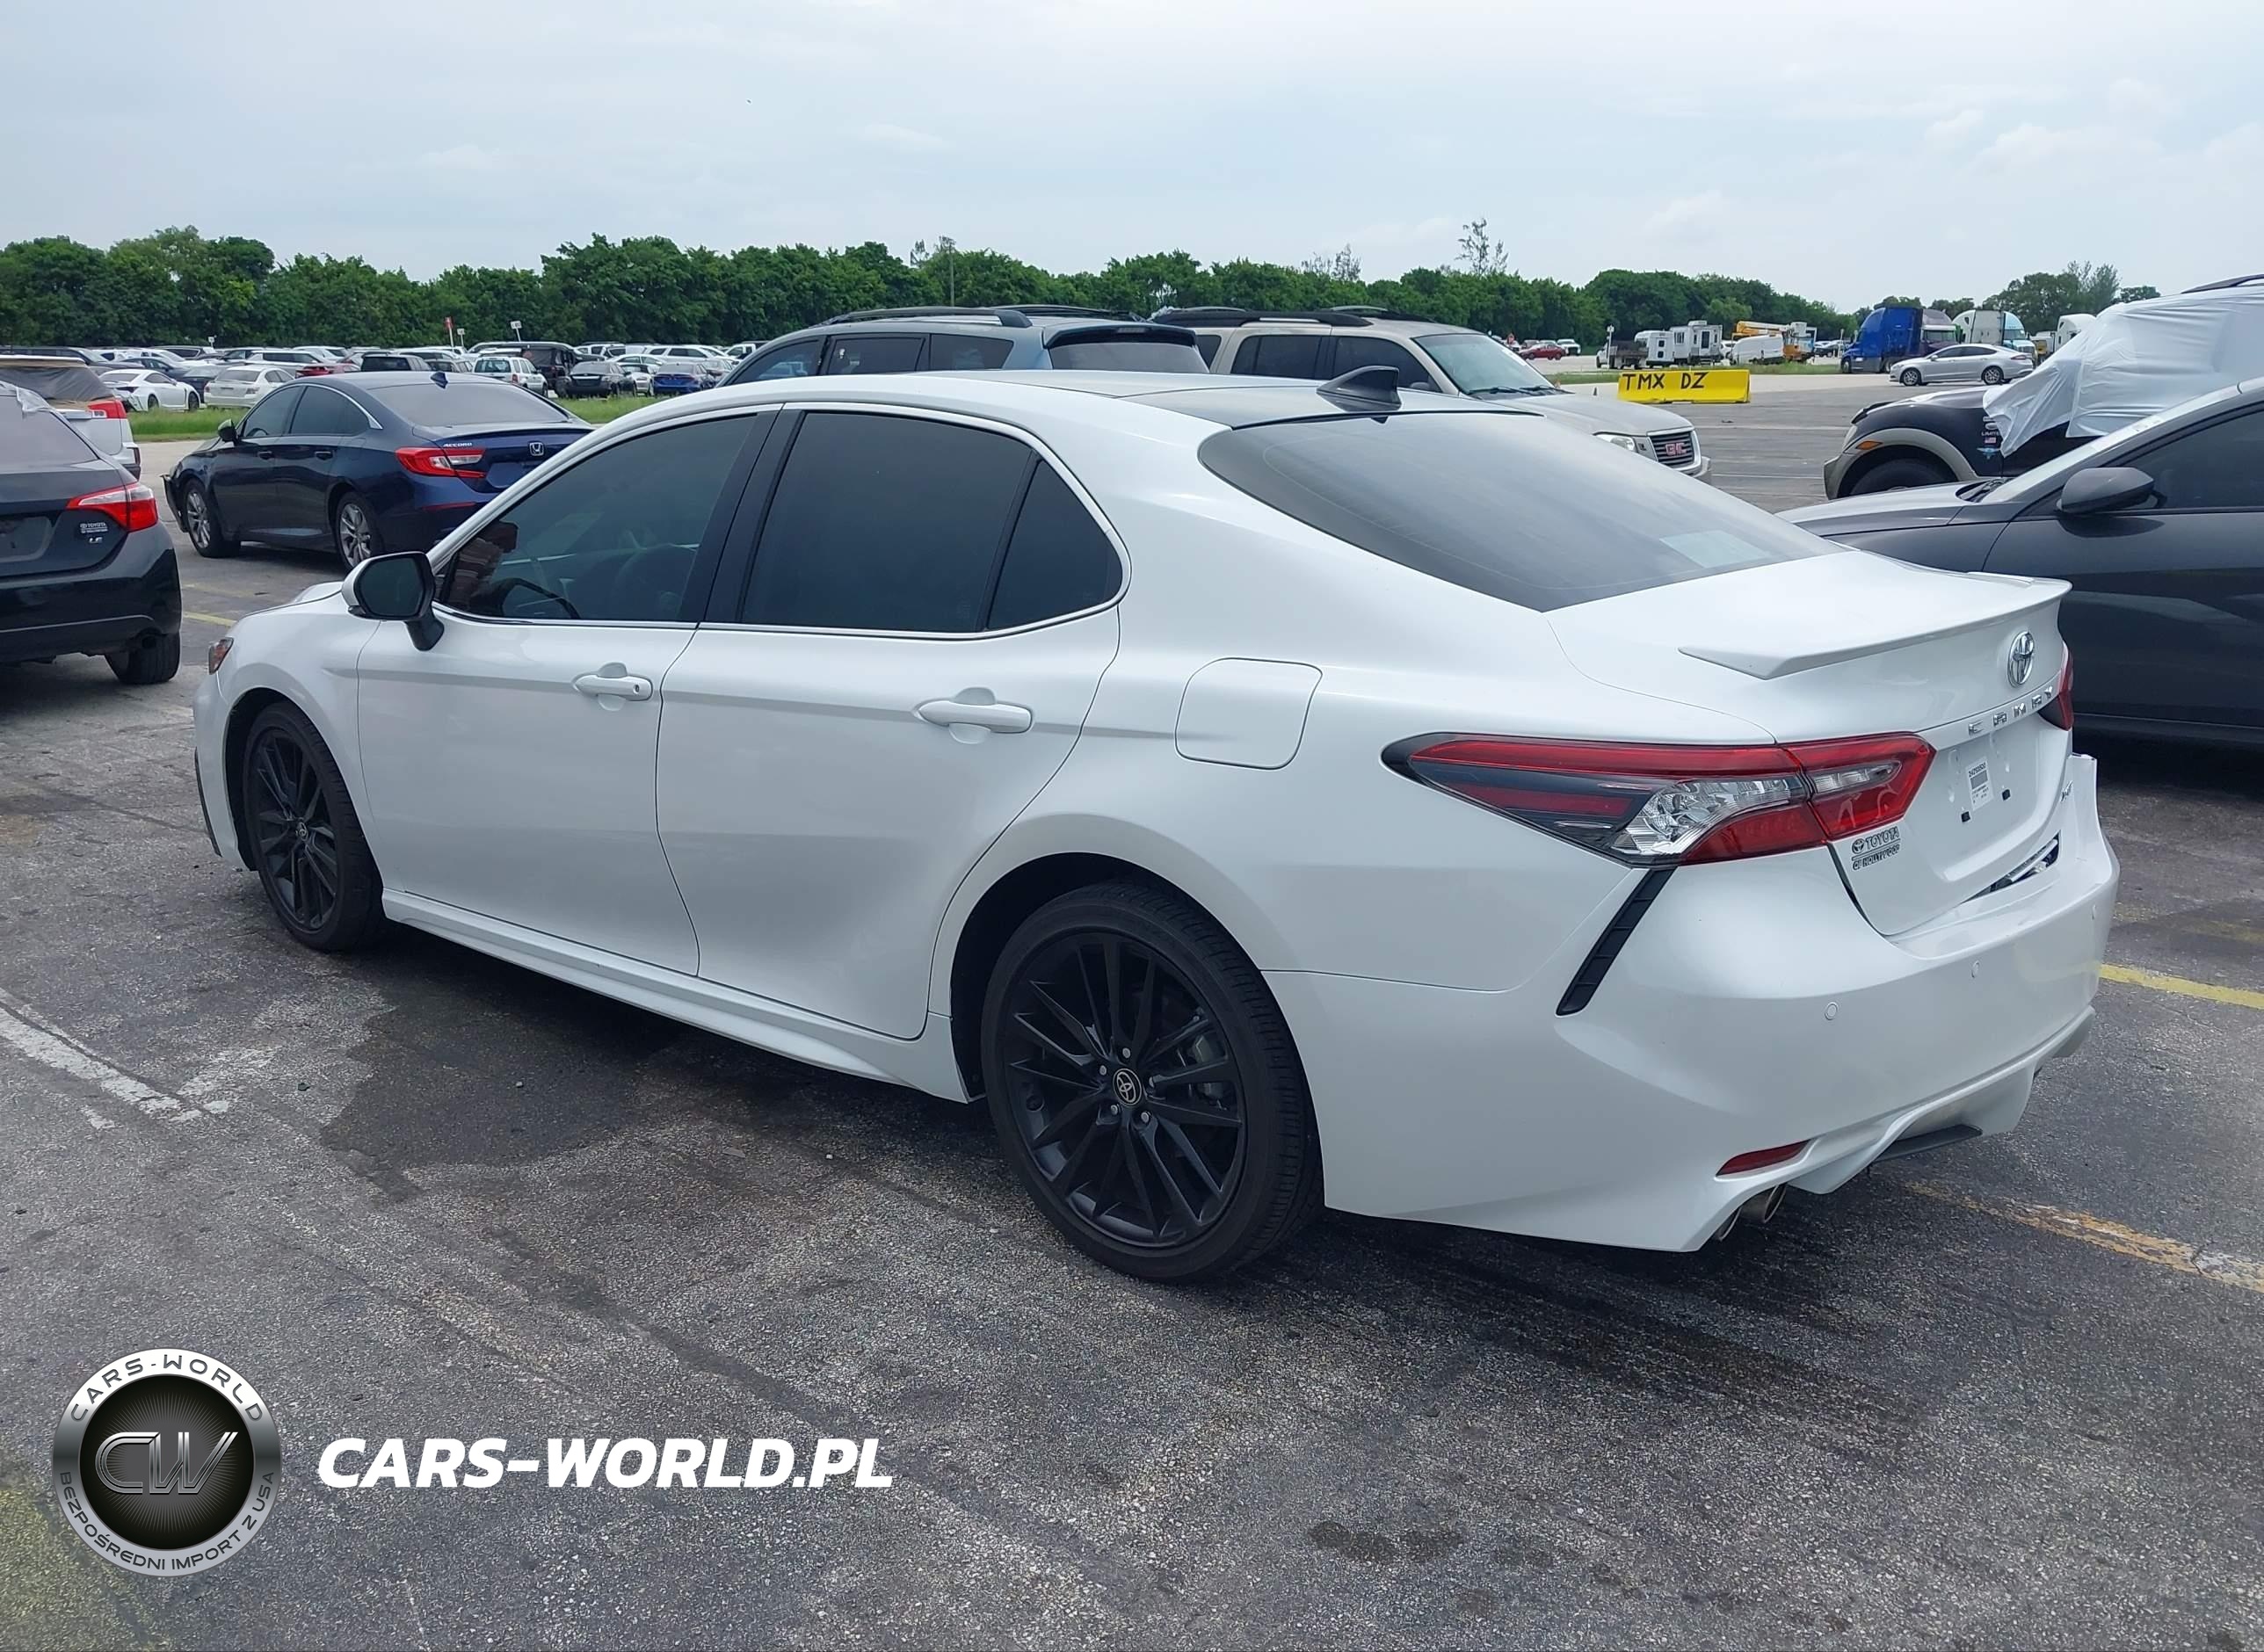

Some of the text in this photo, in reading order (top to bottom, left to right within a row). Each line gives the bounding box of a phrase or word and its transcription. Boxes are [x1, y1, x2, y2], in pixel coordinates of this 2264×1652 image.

[1622, 372, 1709, 391] TMX DZ
[1665, 443, 1687, 456] GMC
[1968, 685, 2053, 736] CAMRY
[1865, 826, 1899, 850] TOYOTA
[1862, 844, 1900, 867] HOLLYWOOD
